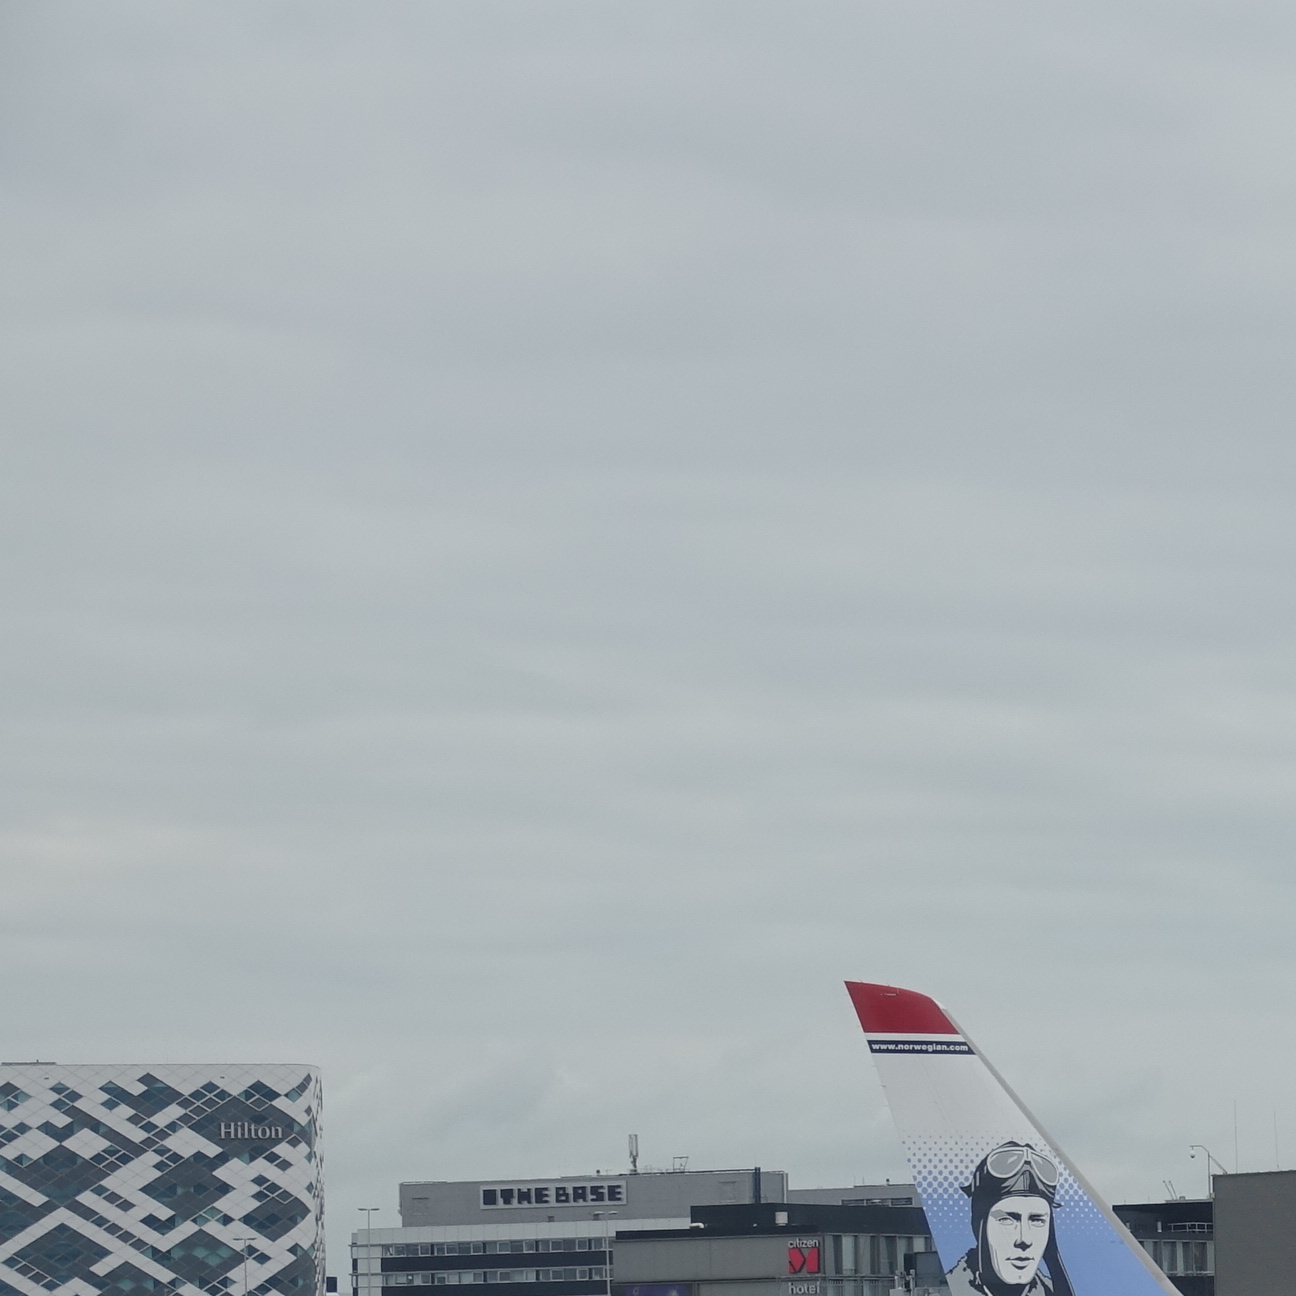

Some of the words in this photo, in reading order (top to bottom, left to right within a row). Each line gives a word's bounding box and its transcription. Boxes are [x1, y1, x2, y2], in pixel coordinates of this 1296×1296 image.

[871, 1043, 968, 1052] www.norwegian.com
[220, 1121, 283, 1139] Hilton
[500, 1187, 550, 1205] THE
[555, 1185, 622, 1203] BASE
[788, 1238, 819, 1248] citizen
[788, 1281, 820, 1294] hotel
